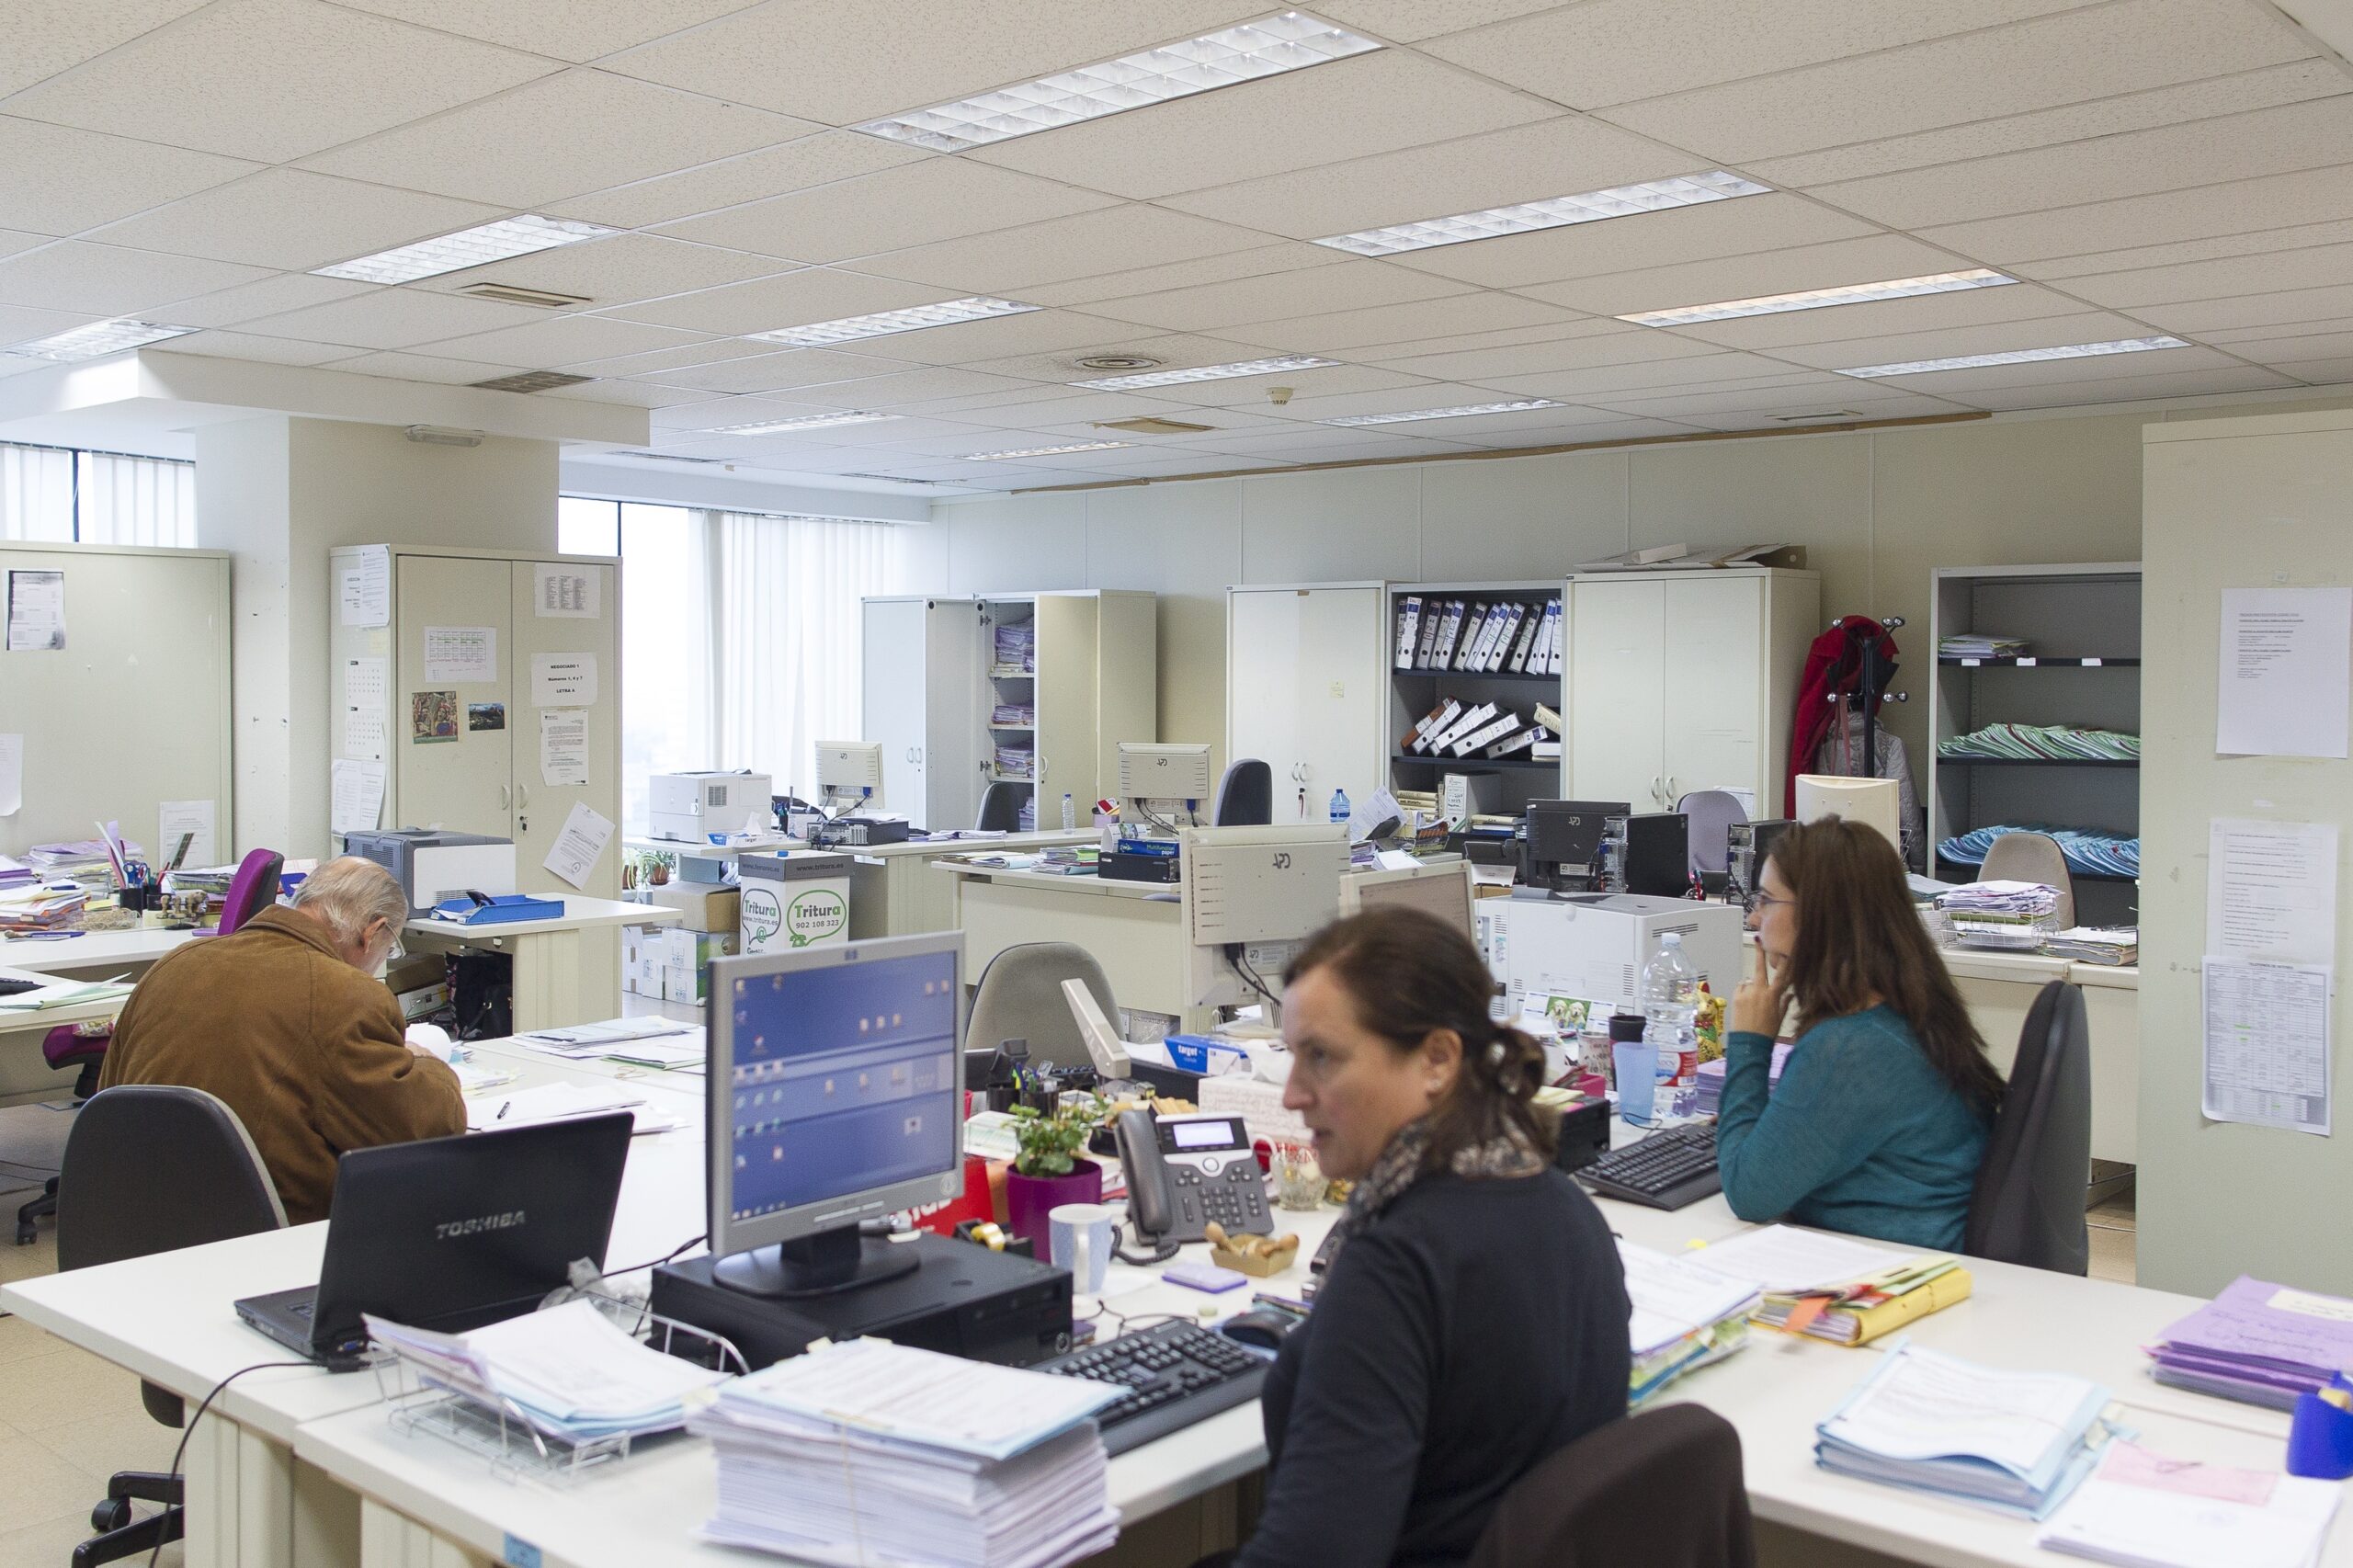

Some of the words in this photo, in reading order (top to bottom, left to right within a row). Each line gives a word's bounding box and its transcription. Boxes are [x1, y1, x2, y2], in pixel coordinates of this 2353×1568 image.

[796, 862, 845, 872] www.tritura.es
[745, 899, 777, 917] Tritura
[794, 904, 841, 918] Tritura
[435, 1210, 525, 1240] TOSHIBA
